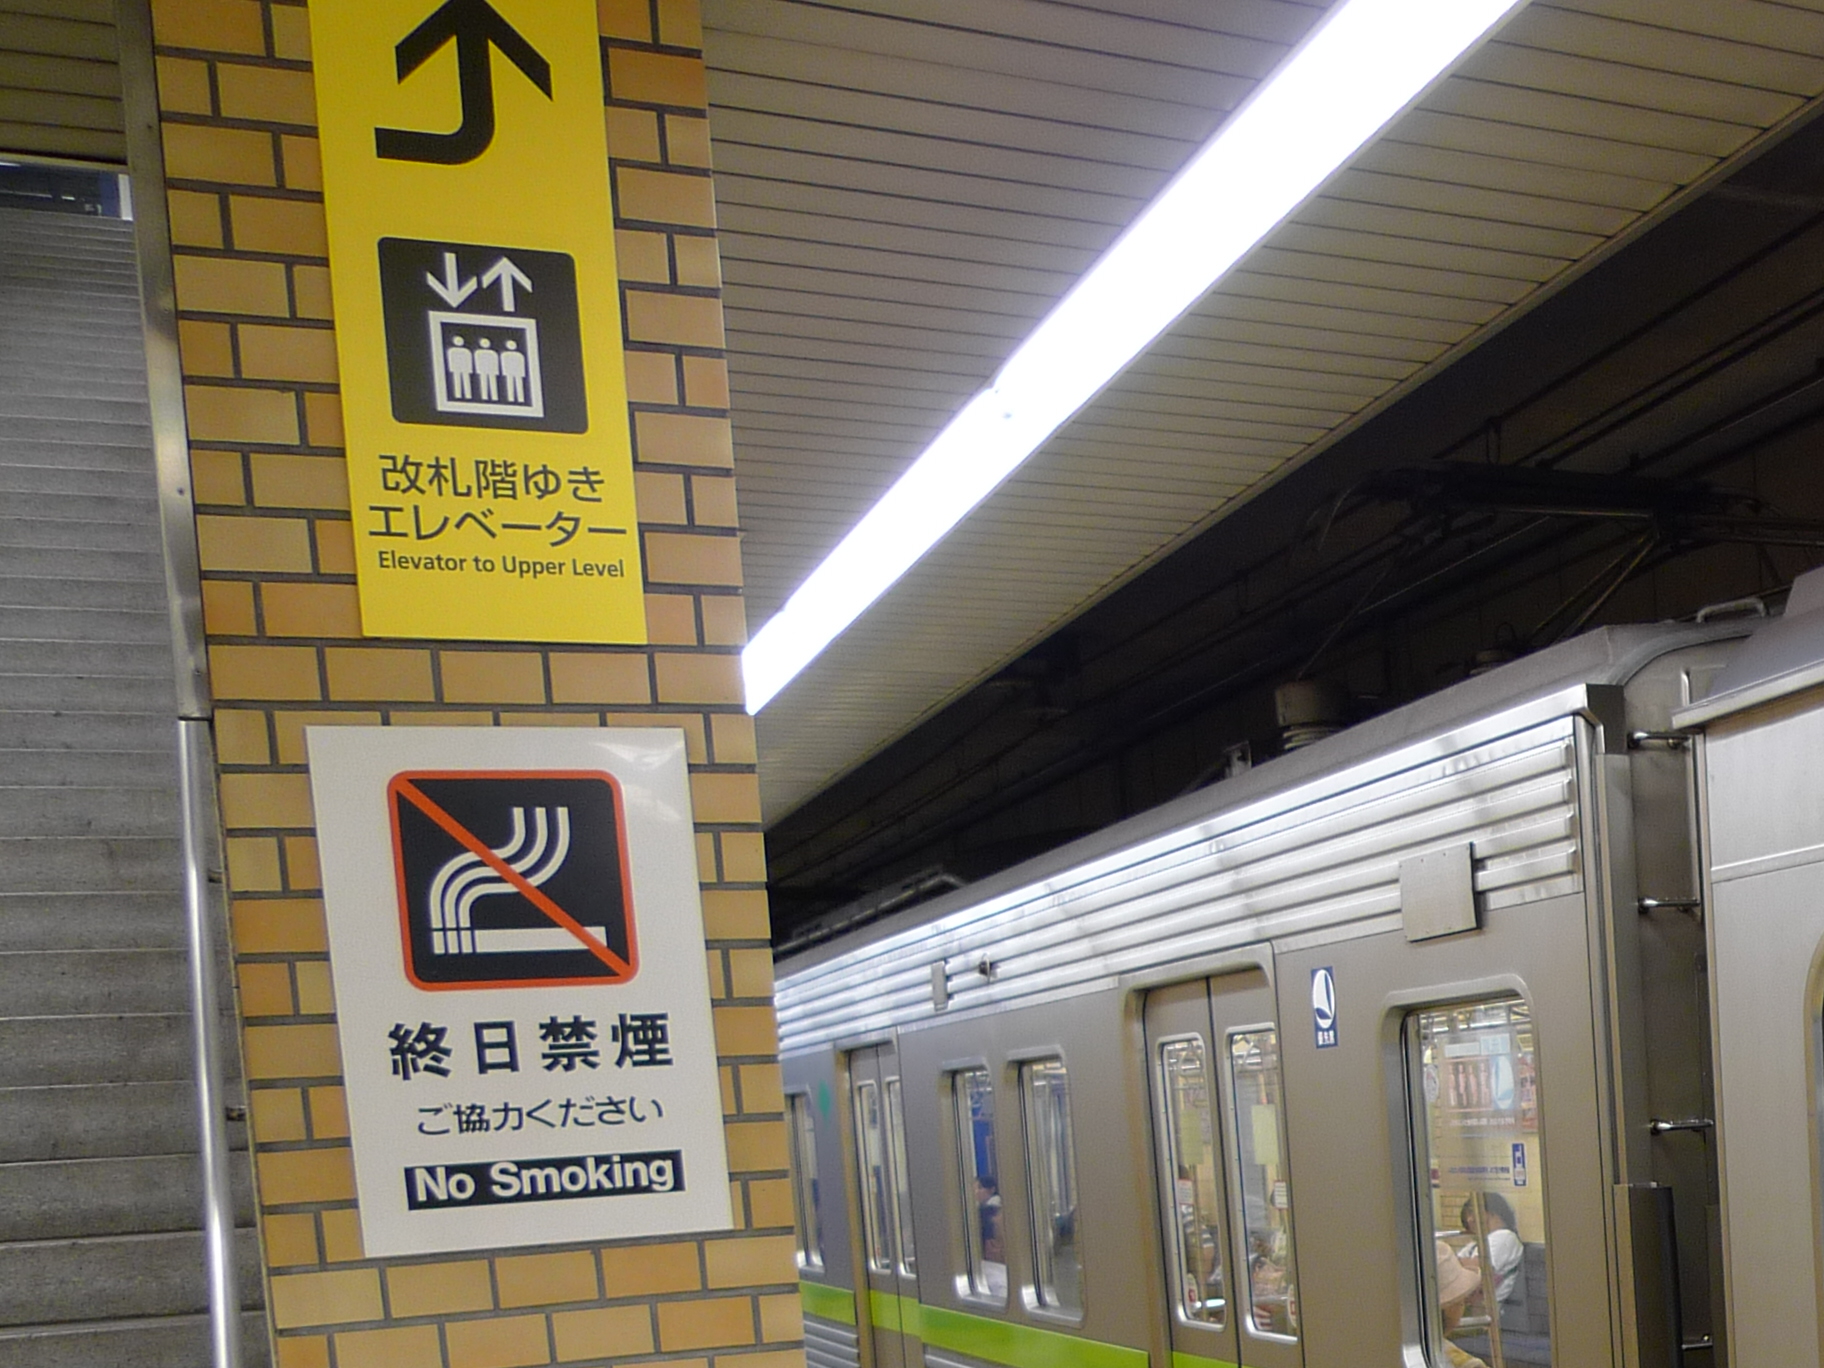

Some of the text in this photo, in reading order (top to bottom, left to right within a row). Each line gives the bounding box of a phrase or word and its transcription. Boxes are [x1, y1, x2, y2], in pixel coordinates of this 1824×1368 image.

[379, 454, 605, 503] 改札階ゆき
[369, 504, 627, 547] エレベーター
[378, 550, 625, 579] Elevator to Upper Level
[388, 1012, 673, 1080] 終日禁煙
[417, 1095, 664, 1135] ご協力ください
[415, 1156, 674, 1201] No Smoking
